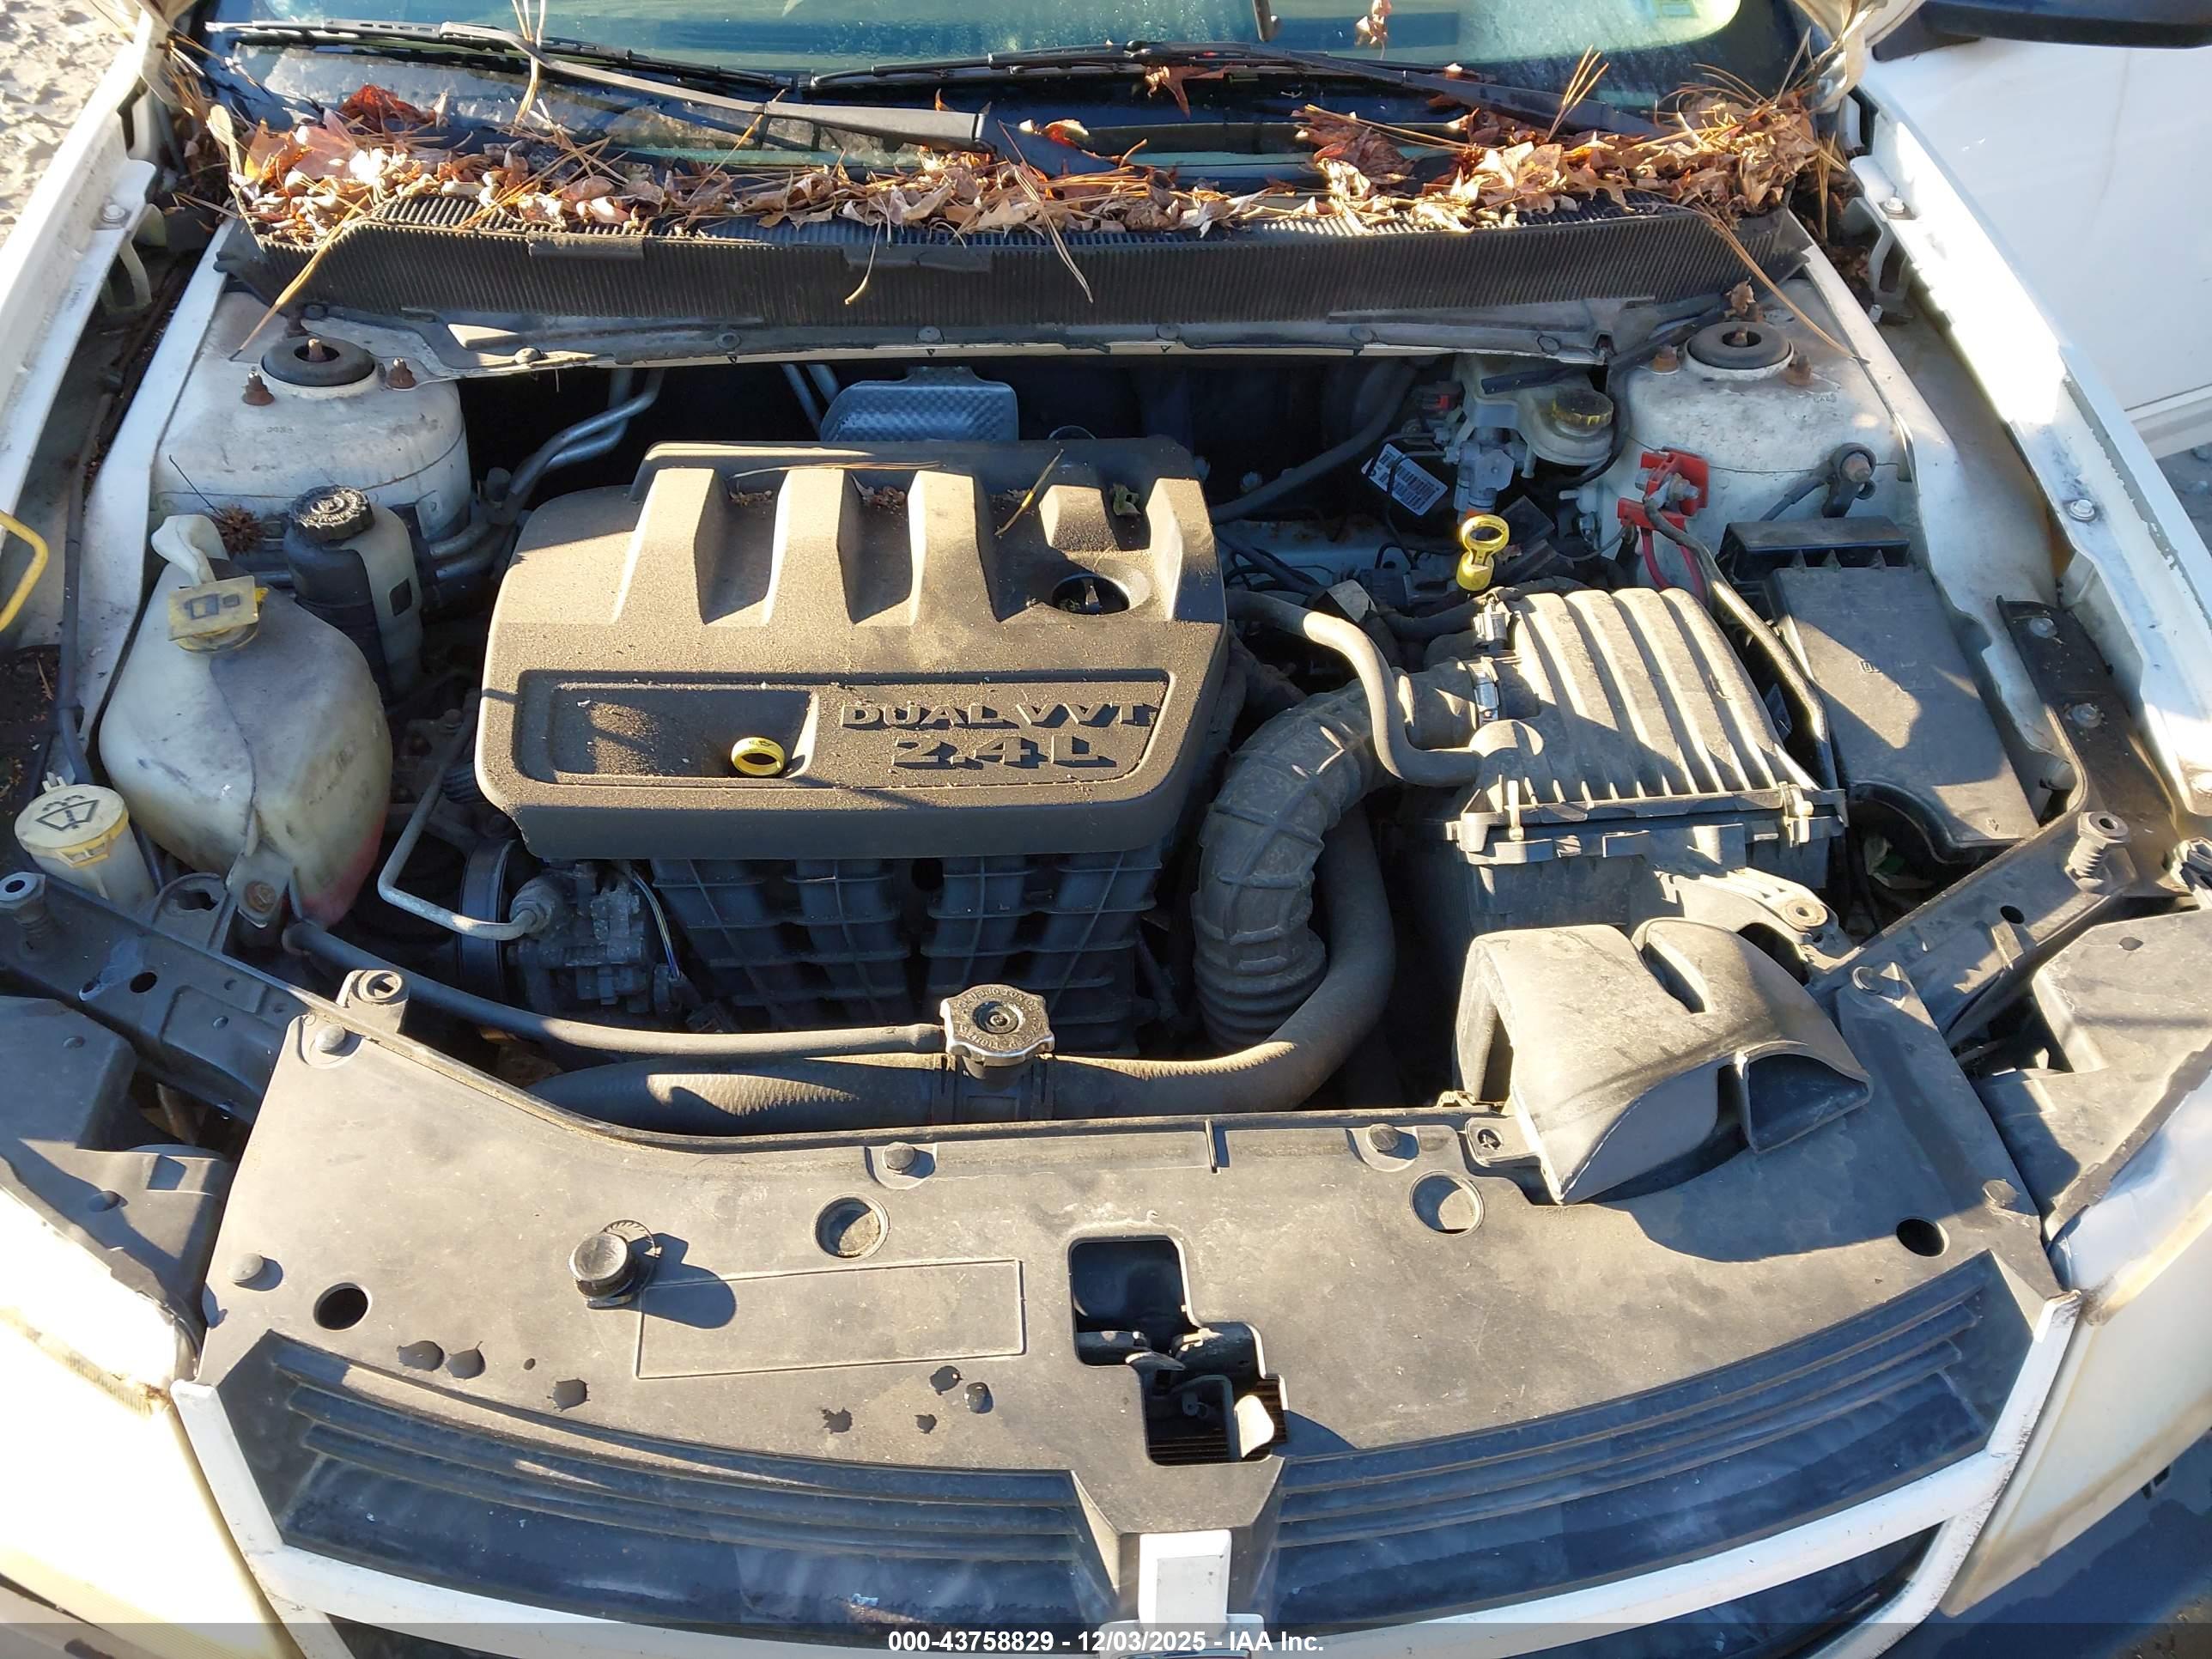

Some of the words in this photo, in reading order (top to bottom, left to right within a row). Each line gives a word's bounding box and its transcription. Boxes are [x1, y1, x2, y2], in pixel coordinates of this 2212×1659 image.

[840, 702, 1010, 728] DUAL
[1015, 702, 1146, 727] VVT
[892, 734, 1102, 768] 2.4L
